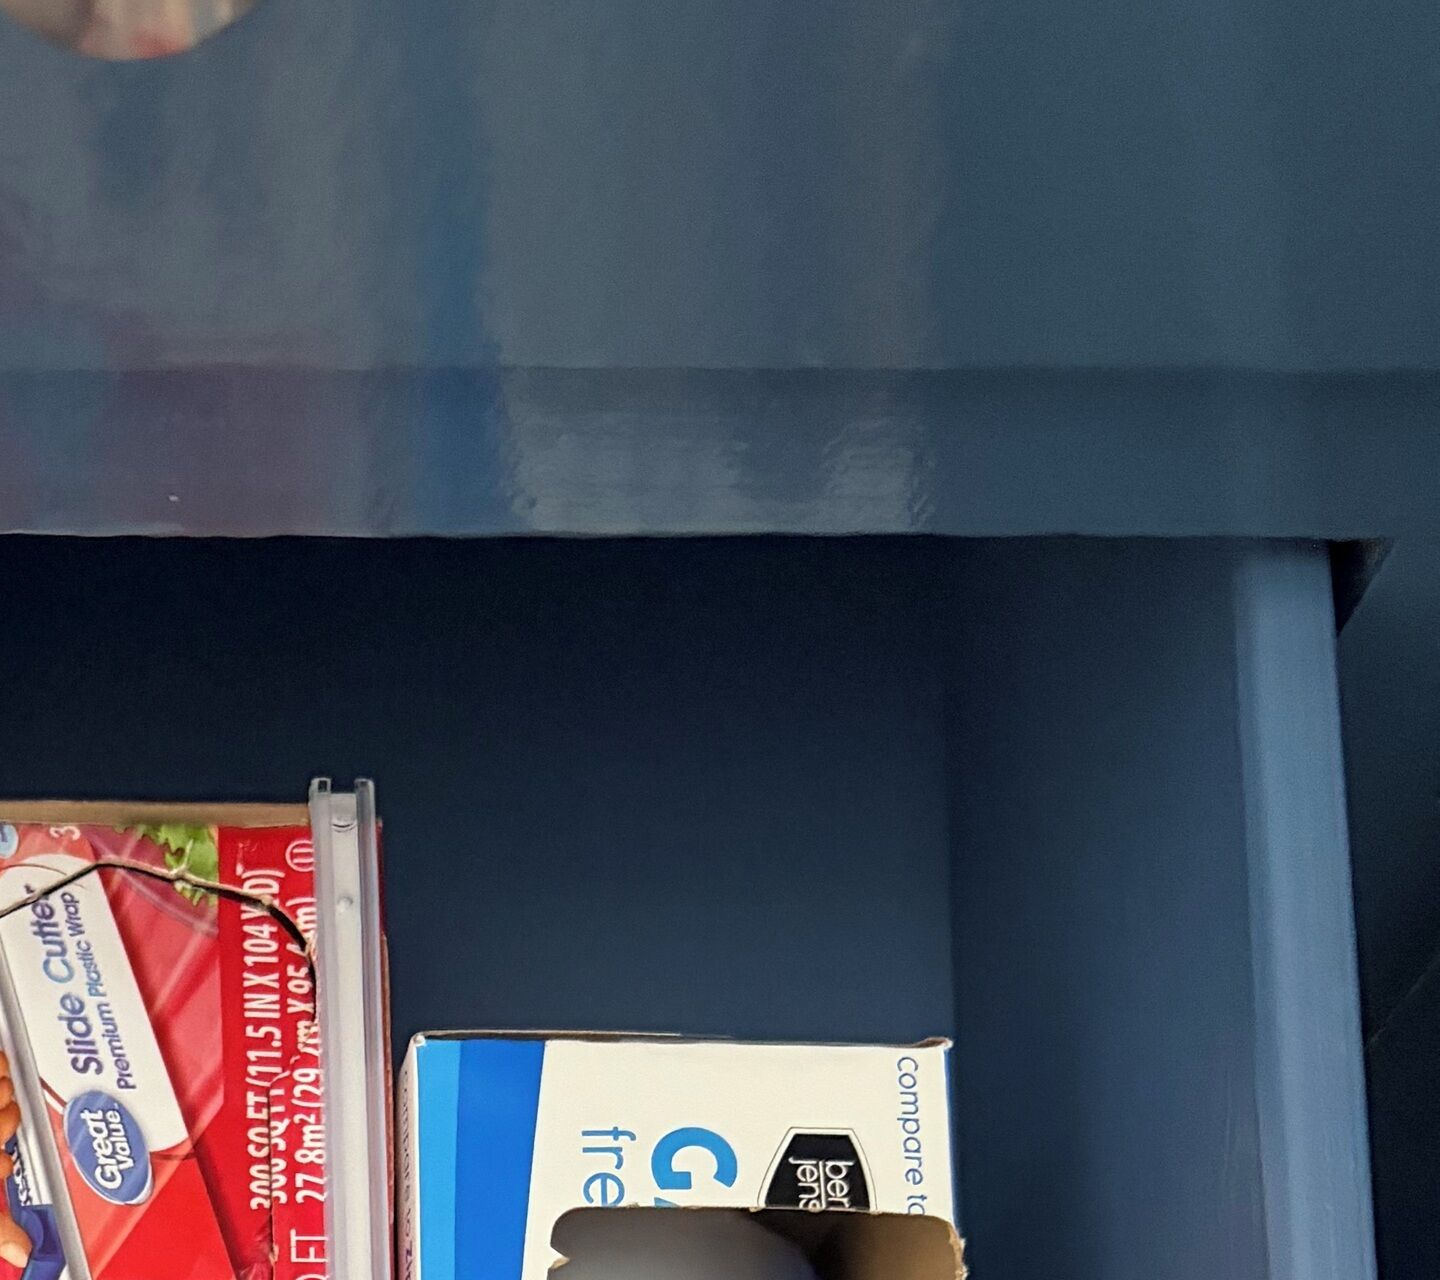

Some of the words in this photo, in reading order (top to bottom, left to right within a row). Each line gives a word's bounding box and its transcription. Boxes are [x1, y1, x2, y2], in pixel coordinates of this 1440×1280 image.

[60, 892, 86, 938] Wrap
[74, 940, 106, 997] Plastic
[242, 924, 279, 967] 104
[242, 972, 280, 989] X
[244, 993, 281, 1018] IN
[57, 993, 104, 1076] Slide
[95, 1002, 136, 1090] Premium
[245, 1025, 290, 1087] (11.5
[246, 1091, 286, 1118] FT
[897, 1056, 925, 1186] compare
[77, 1107, 123, 1190] Great
[247, 1119, 291, 1159] SQ
[249, 1158, 288, 1210] 300
[651, 1127, 738, 1208] G
[290, 1228, 328, 1264] FT
